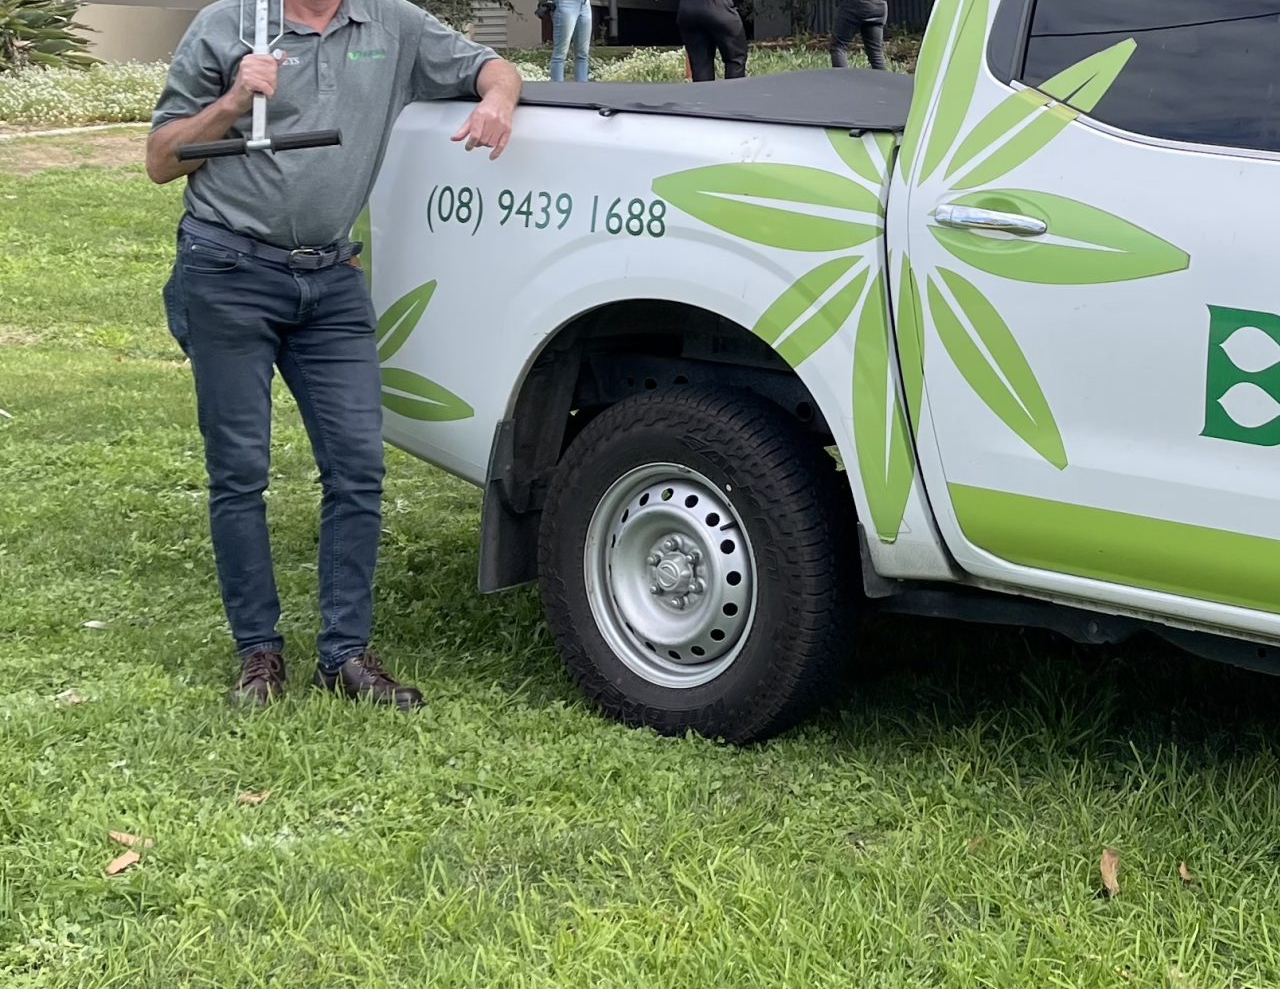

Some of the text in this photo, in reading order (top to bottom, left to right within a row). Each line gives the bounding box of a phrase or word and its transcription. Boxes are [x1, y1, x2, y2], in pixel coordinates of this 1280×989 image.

[427, 185, 667, 238] (08) 9439 1688
